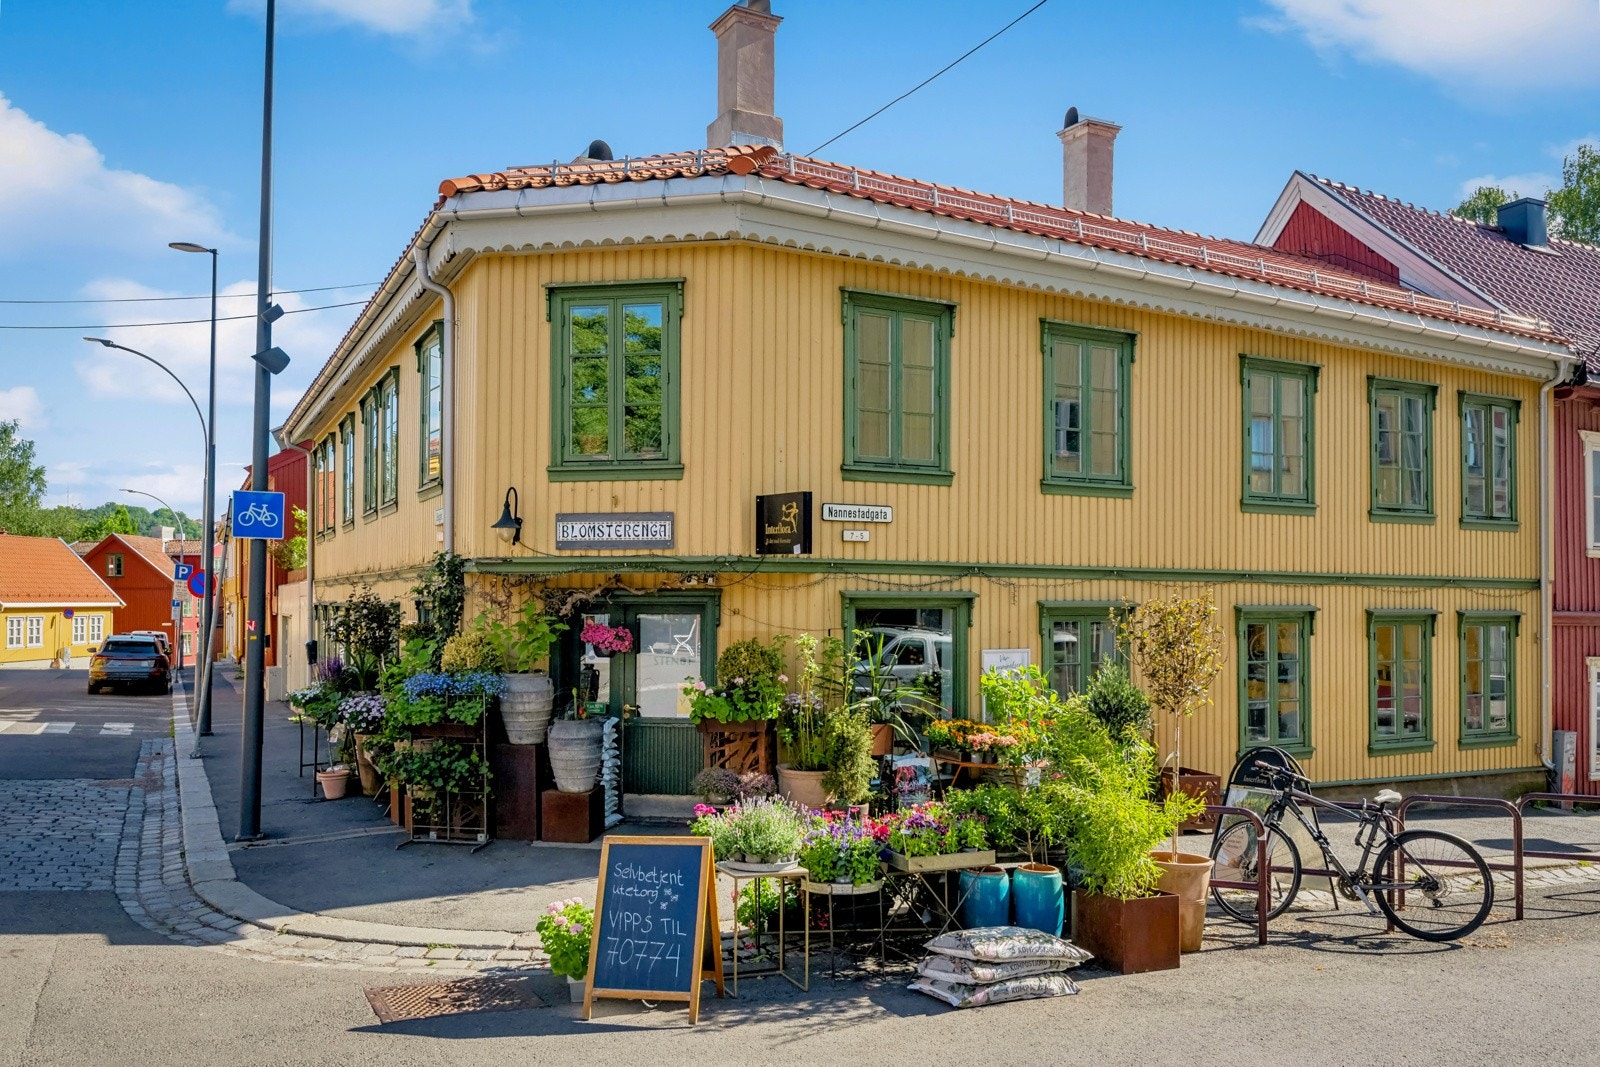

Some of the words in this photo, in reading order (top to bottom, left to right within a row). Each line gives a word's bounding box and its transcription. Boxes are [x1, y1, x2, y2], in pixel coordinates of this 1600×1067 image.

[827, 506, 888, 521] Nannestadgata
[561, 524, 667, 539] BLOMSTERENGA
[765, 522, 791, 534] Interflora
[178, 566, 189, 578] P
[613, 862, 684, 889] Selvbetjent
[612, 884, 659, 904] utetorg
[609, 910, 653, 933] VIPPS
[660, 918, 687, 936] TIL
[607, 936, 681, 977] 70774
